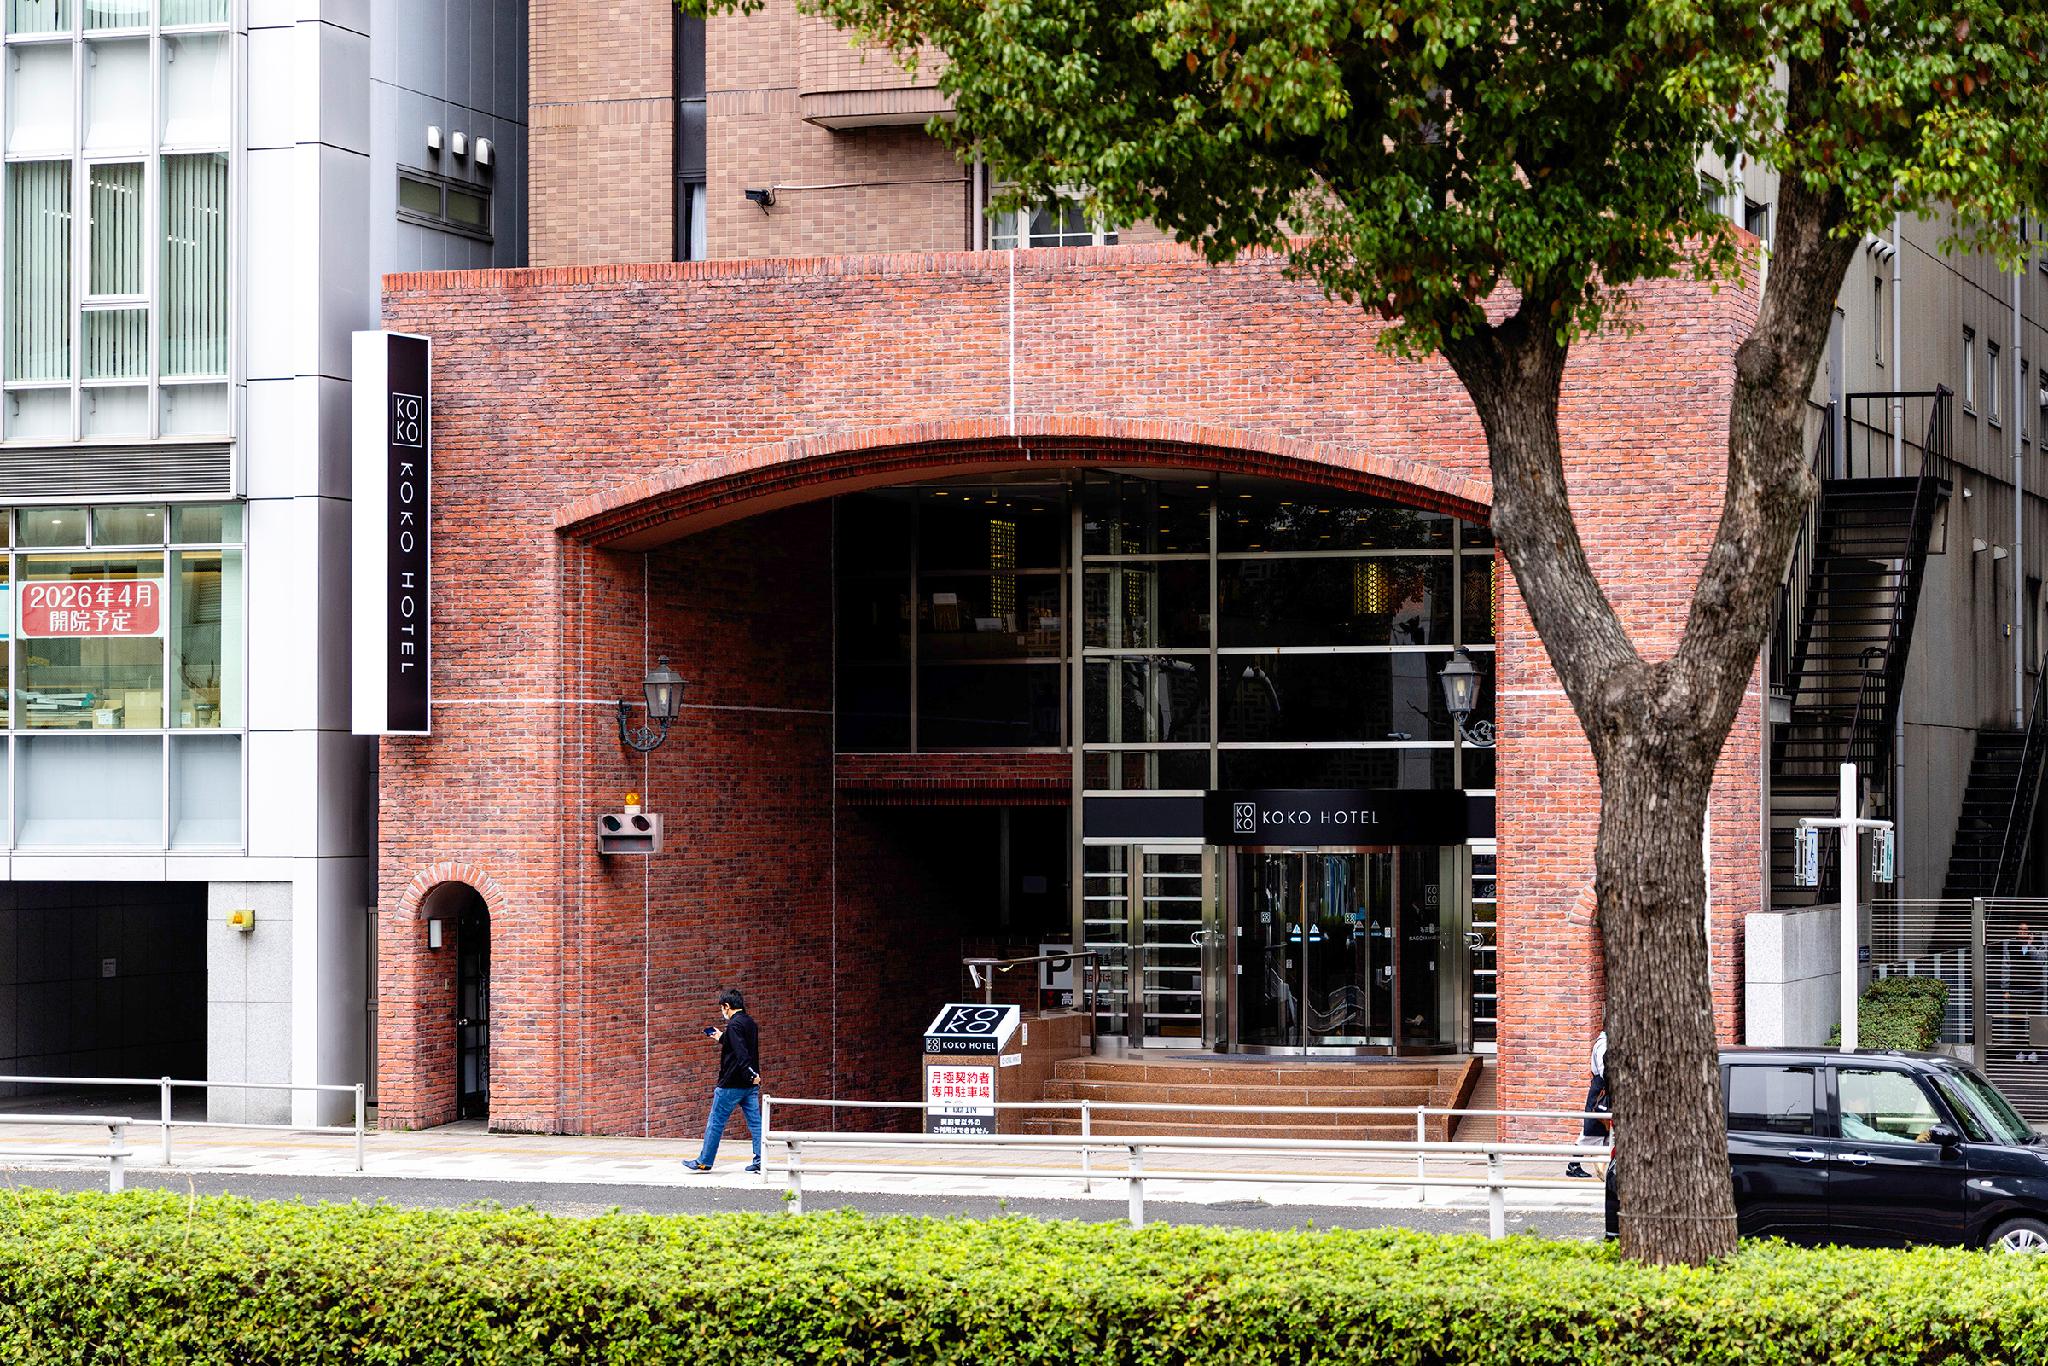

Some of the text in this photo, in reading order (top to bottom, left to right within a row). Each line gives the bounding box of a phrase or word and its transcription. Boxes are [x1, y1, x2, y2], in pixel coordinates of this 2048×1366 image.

[396, 398, 419, 420] KO
[396, 421, 419, 442] KO
[400, 462, 415, 673] KOKO HOTEL
[30, 584, 152, 608] 2026年4月
[49, 609, 132, 632] 開院予定
[1236, 805, 1253, 817] KO
[1262, 810, 1379, 824] KOKO HOTEL
[1236, 818, 1253, 830] KO
[1046, 950, 1072, 985] P
[952, 1008, 999, 1021] KO
[943, 1020, 992, 1033] KO
[969, 1042, 996, 1050] HOTEL
[931, 1071, 990, 1084] 月極契約者
[931, 1085, 990, 1098] 専用駐車場
